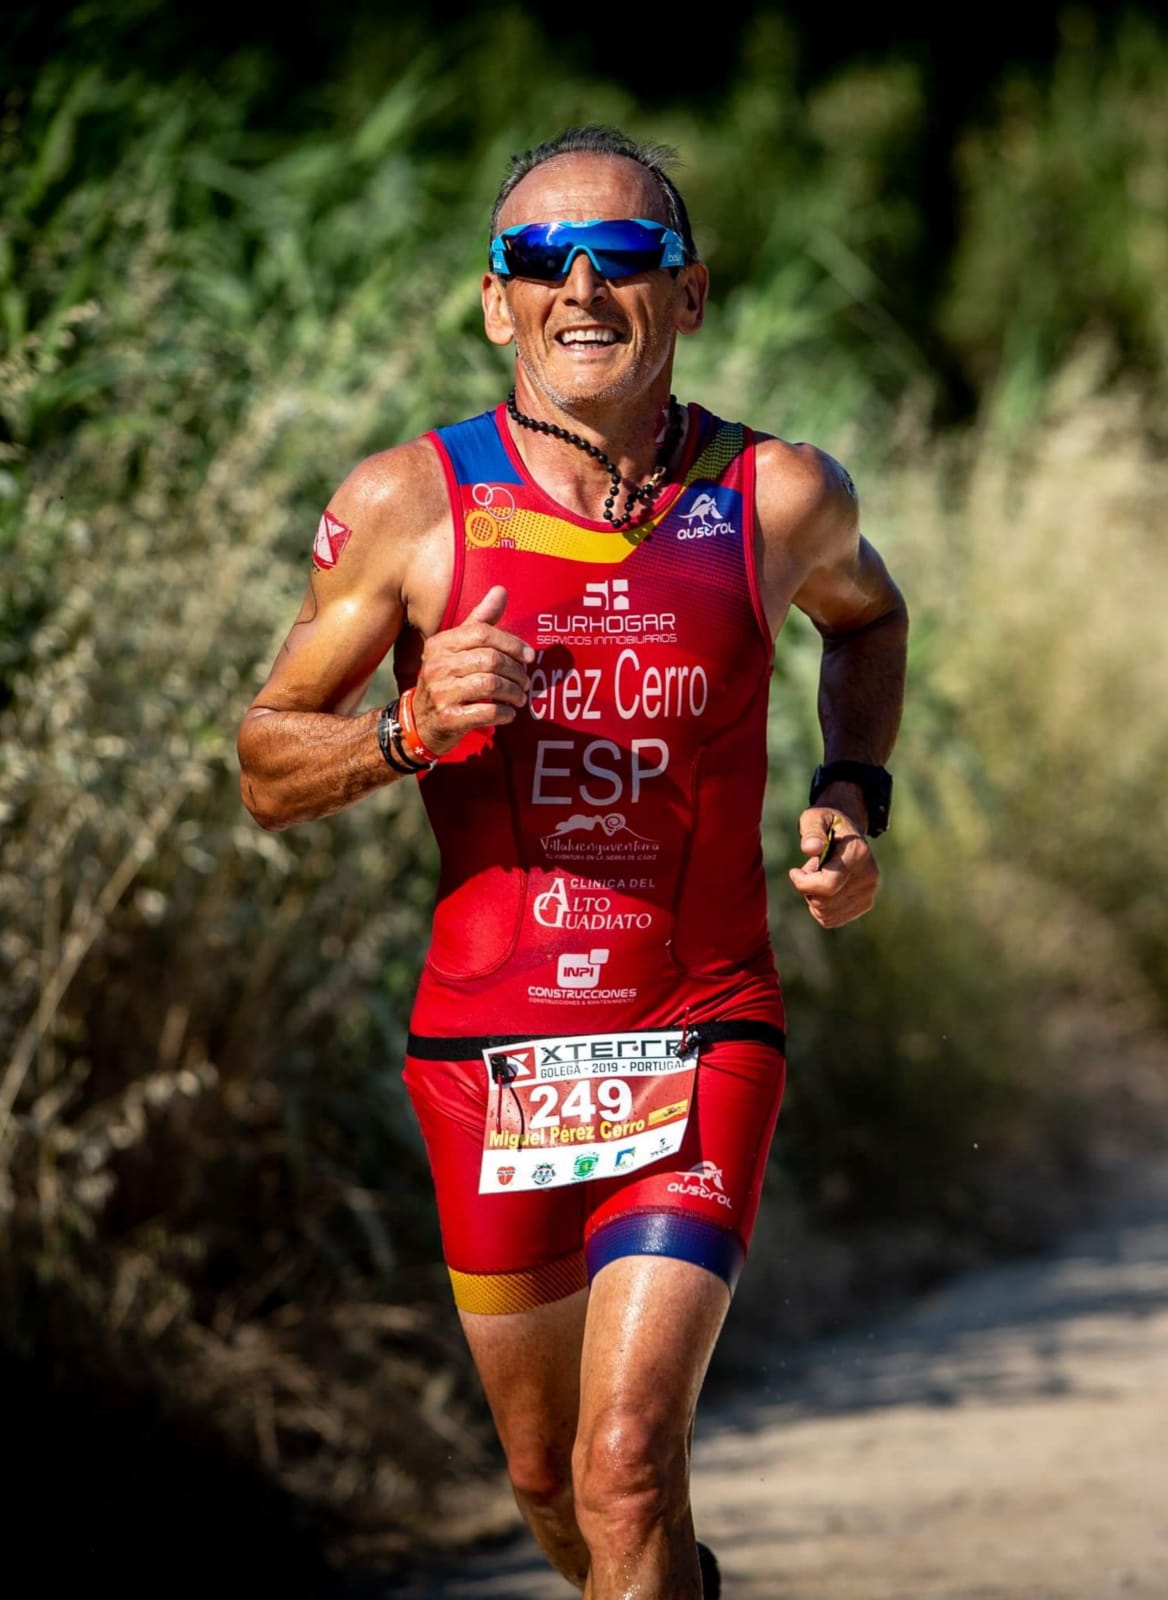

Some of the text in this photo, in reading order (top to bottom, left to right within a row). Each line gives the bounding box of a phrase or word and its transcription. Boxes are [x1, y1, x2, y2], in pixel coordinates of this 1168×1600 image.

[537, 613, 676, 633] SURHOGAR
[526, 648, 708, 720] érez Cerro
[532, 738, 670, 806] ESP
[629, 878, 656, 888] DEL
[541, 877, 611, 913] ALTO
[563, 967, 594, 978] INPI
[528, 986, 637, 999] CONSTRUCCIONES
[592, 1062, 618, 1074] 2019
[630, 1060, 688, 1073] PORTUGAL
[529, 1079, 633, 1130] 249
[551, 1124, 595, 1143] Pérez
[600, 1120, 645, 1140] Cerro
